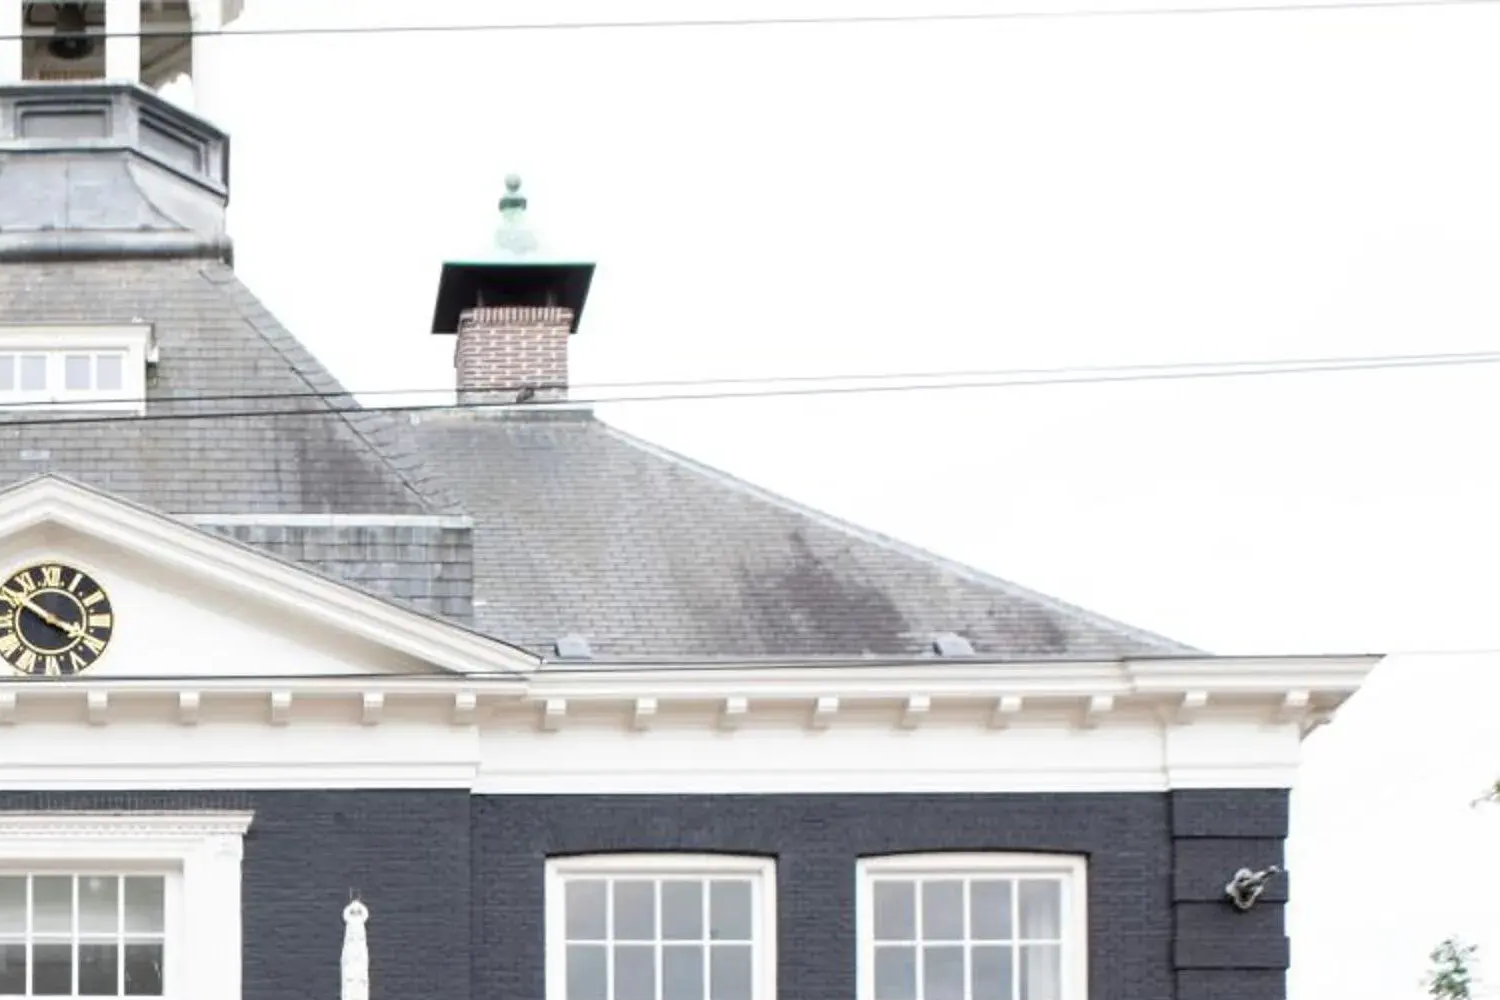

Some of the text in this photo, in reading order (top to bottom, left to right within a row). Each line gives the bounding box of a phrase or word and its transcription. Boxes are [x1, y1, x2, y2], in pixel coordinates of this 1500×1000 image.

[41, 566, 61, 587] XII
[68, 573, 83, 592] I
[69, 651, 88, 672] V
